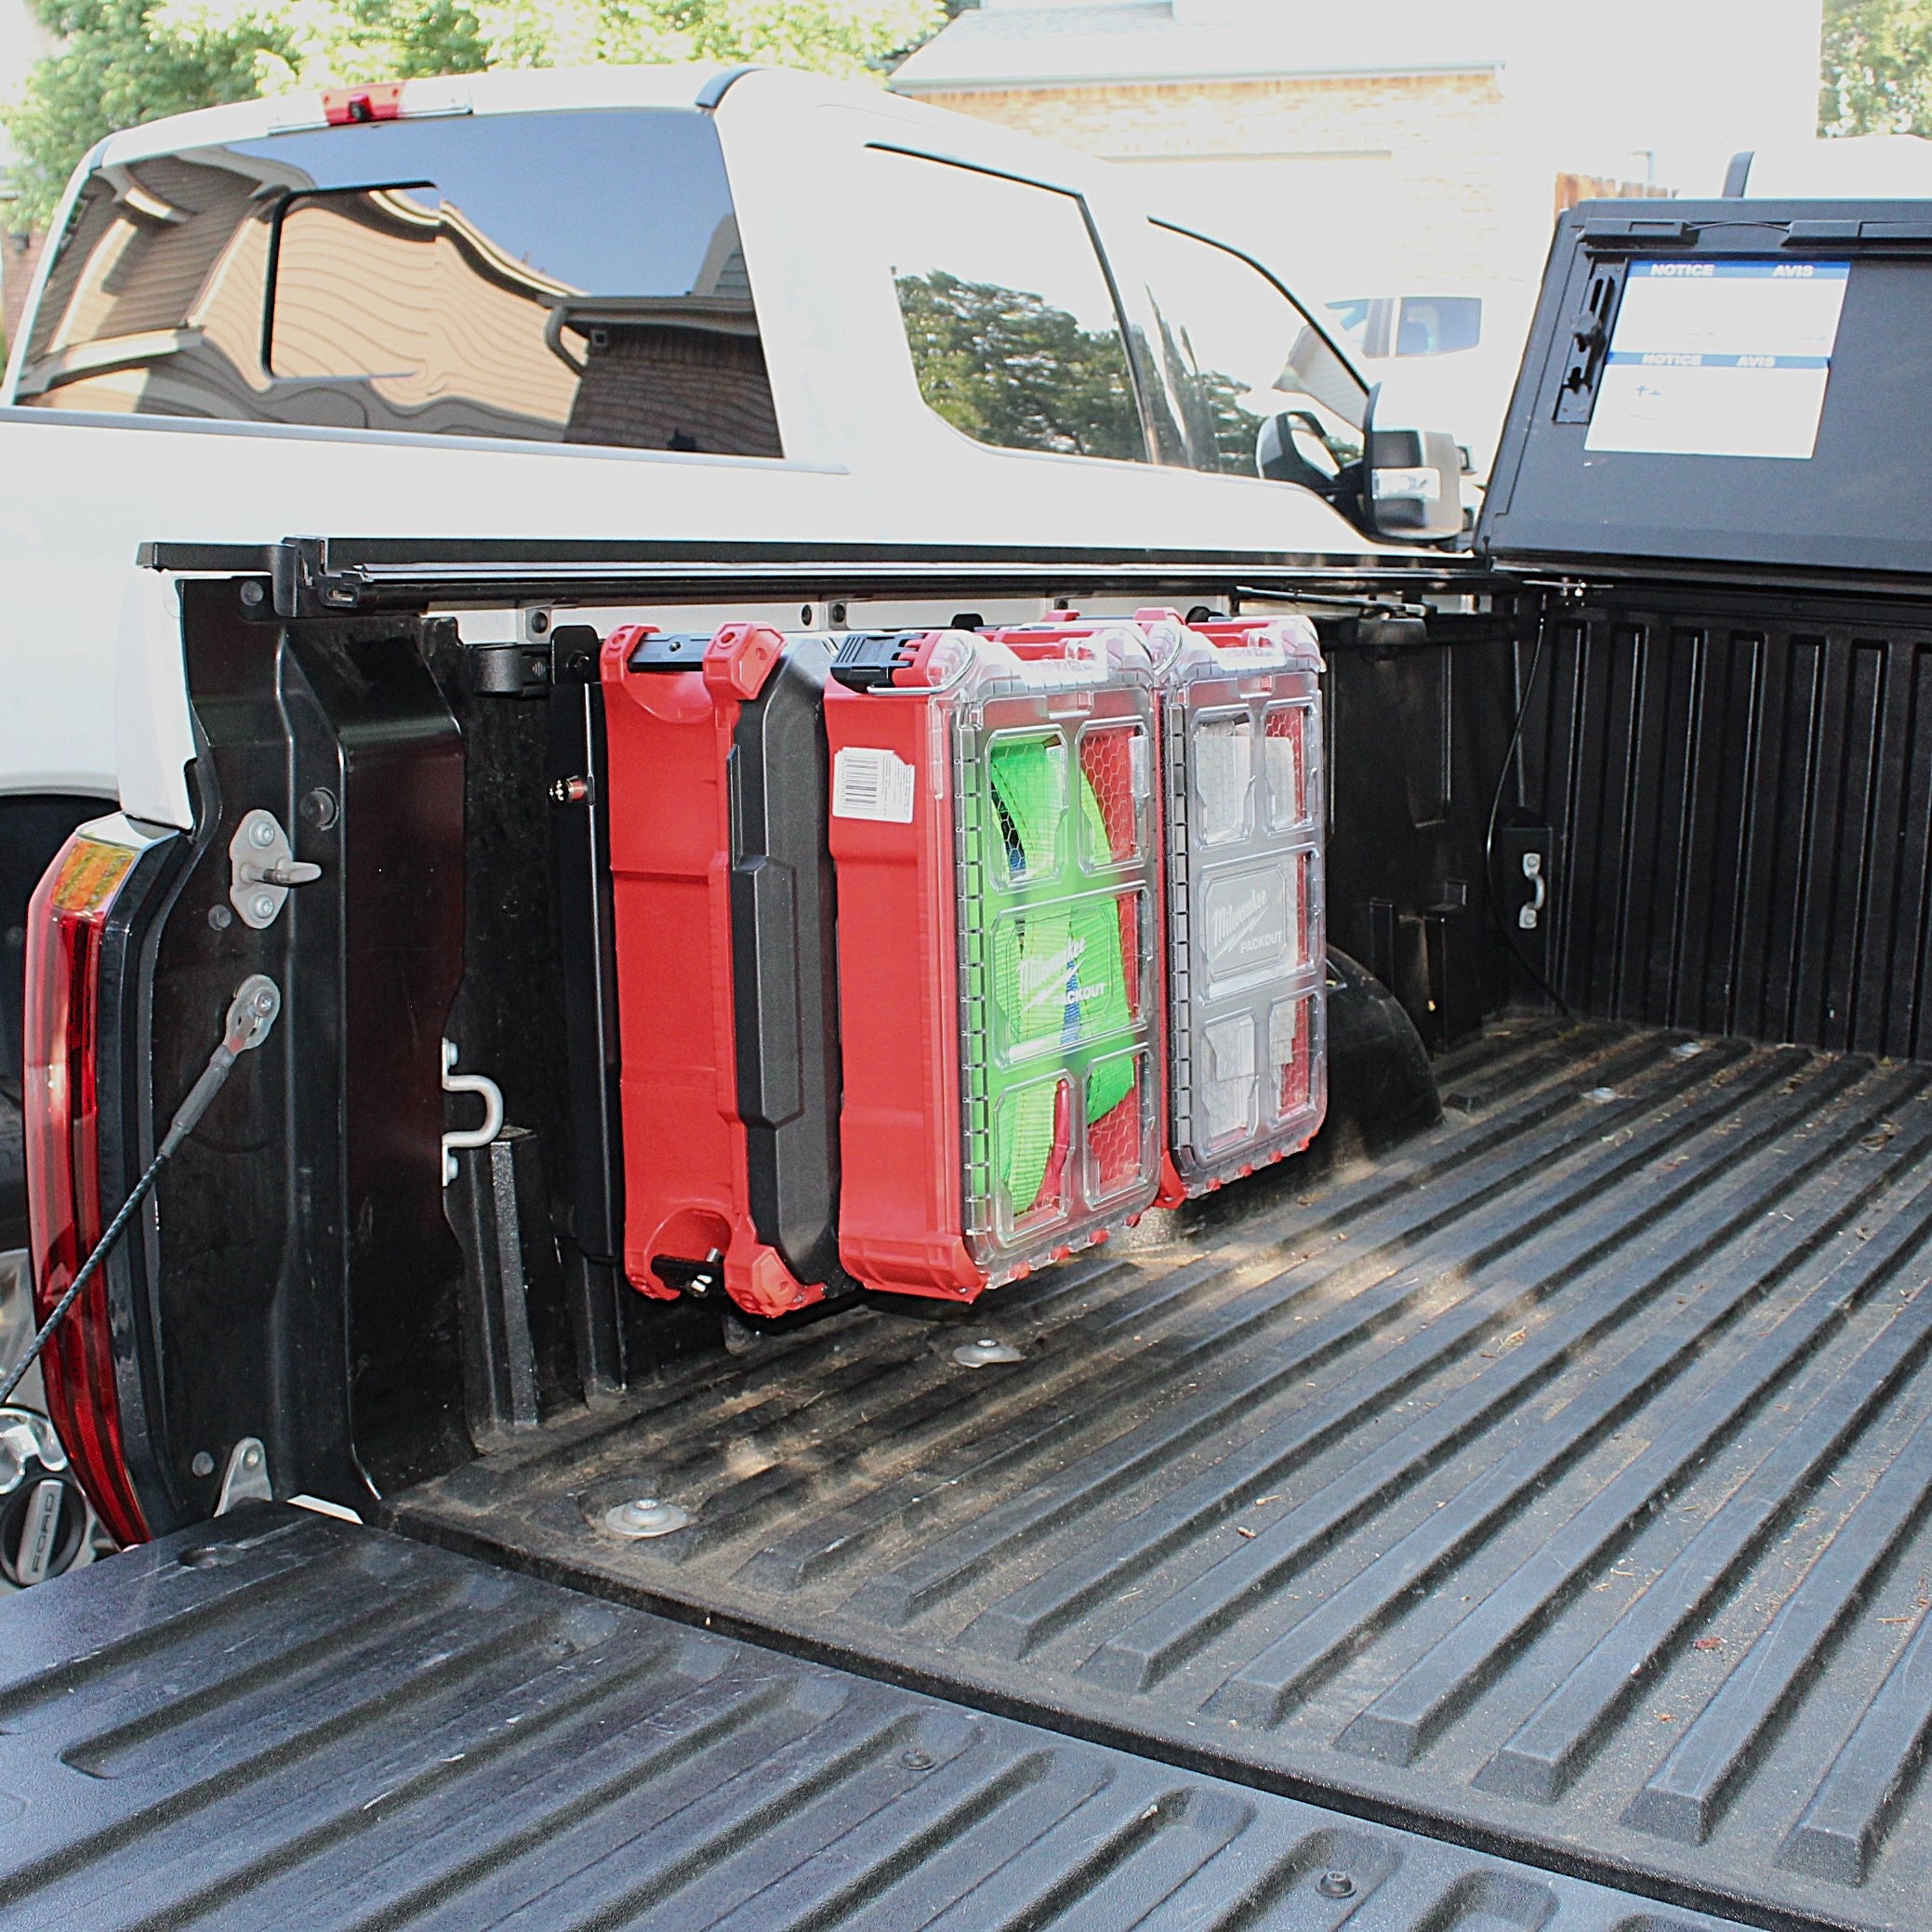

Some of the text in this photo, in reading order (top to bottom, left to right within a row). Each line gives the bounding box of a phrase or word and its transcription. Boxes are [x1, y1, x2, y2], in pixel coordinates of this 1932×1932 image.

[1650, 263, 1815, 278] NOTICE AVIS
[1642, 353, 1776, 368] NOTICE AVIS
[1211, 889, 1268, 948] Milwaukee
[1240, 930, 1283, 954] PACKOUT
[1052, 982, 1106, 1008] PACKOUT
[32, 1493, 55, 1572] FORD
